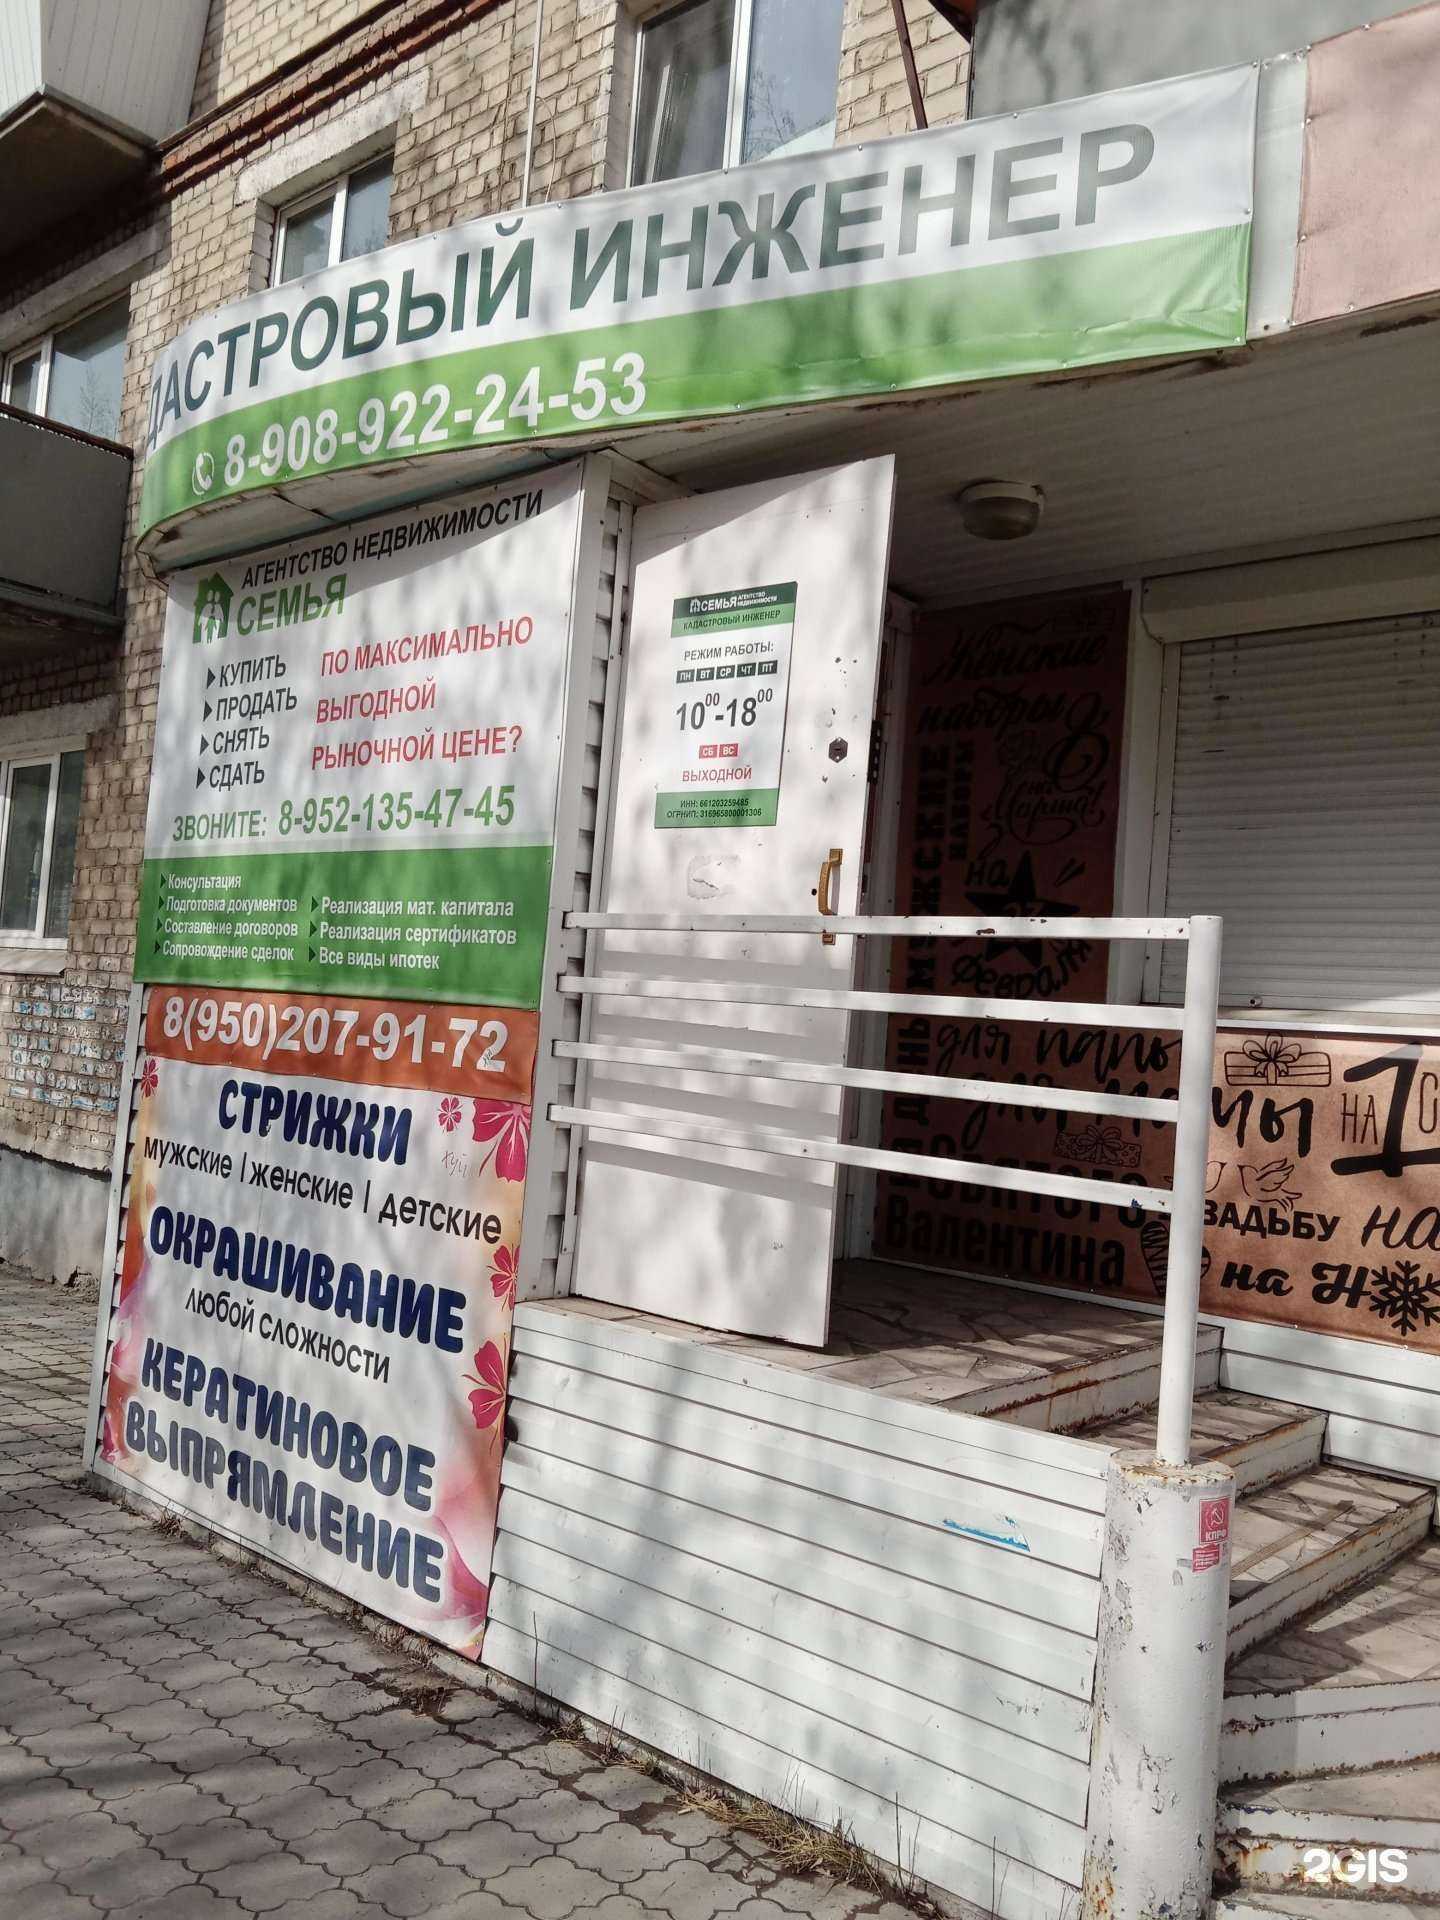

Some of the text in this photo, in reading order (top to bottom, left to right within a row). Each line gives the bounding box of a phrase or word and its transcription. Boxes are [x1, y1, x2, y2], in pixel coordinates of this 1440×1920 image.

[570, 124, 1156, 311] ИНЖЕНЕР
[224, 351, 646, 487] 8-908-922-24-53
[241, 489, 543, 590] АГЕНТСТВО НЕДВИЖИМОСТИ
[236, 573, 347, 636] СЕМЬЯ
[684, 610, 781, 630] КАДАСТРОВЫЙ ИНЖЕНЕР
[701, 596, 737, 612] СЕМЬЯ
[321, 616, 533, 677] ПО МАКСИМАЛЬНО
[684, 641, 774, 661] РЕЖИМ РАБОТЫ:
[219, 654, 287, 689] КУПИТЬ
[680, 663, 774, 682] ПН ВТ СР ЧТ ПТ
[216, 687, 297, 721] ПРОДАТЬ
[316, 677, 436, 724] ВЫГОДНОЙ
[212, 726, 270, 755] СНЯТЬ
[312, 725, 523, 771] РЫНОЧНОЙ ЦЕНЕ?
[702, 745, 735, 757] СБ ВС
[209, 762, 265, 792] СДАТЬ
[682, 766, 752, 783] ВЫХОДНОЙ
[172, 785, 516, 842] ЗВОНИТЕ: 8-952-135-47-45
[168, 874, 241, 892] Консультация
[167, 896, 297, 915] Подготовка документов
[321, 896, 514, 917] Реализация мат. капитала
[164, 918, 298, 939] Составление договоров
[320, 921, 517, 947] Реализация сертификатов
[163, 940, 295, 962] Сопровождение сделок
[319, 947, 440, 970] Все виды ипотек
[163, 996, 509, 1073] 8(950)207-91-72
[218, 1079, 413, 1165] СТРИЖКИ
[145, 1135, 502, 1244] мужские женские детские
[1203, 1200, 1341, 1241] ВАДЬБУ
[150, 1205, 467, 1353] ОКРАШИВАНИЕ
[1221, 1262, 1293, 1296] на
[186, 1287, 390, 1384] любой сложности
[141, 1337, 436, 1512] КЕРАТИНОВОЕ
[126, 1400, 444, 1603] ВЫПРЯМЛЕНИЕ
